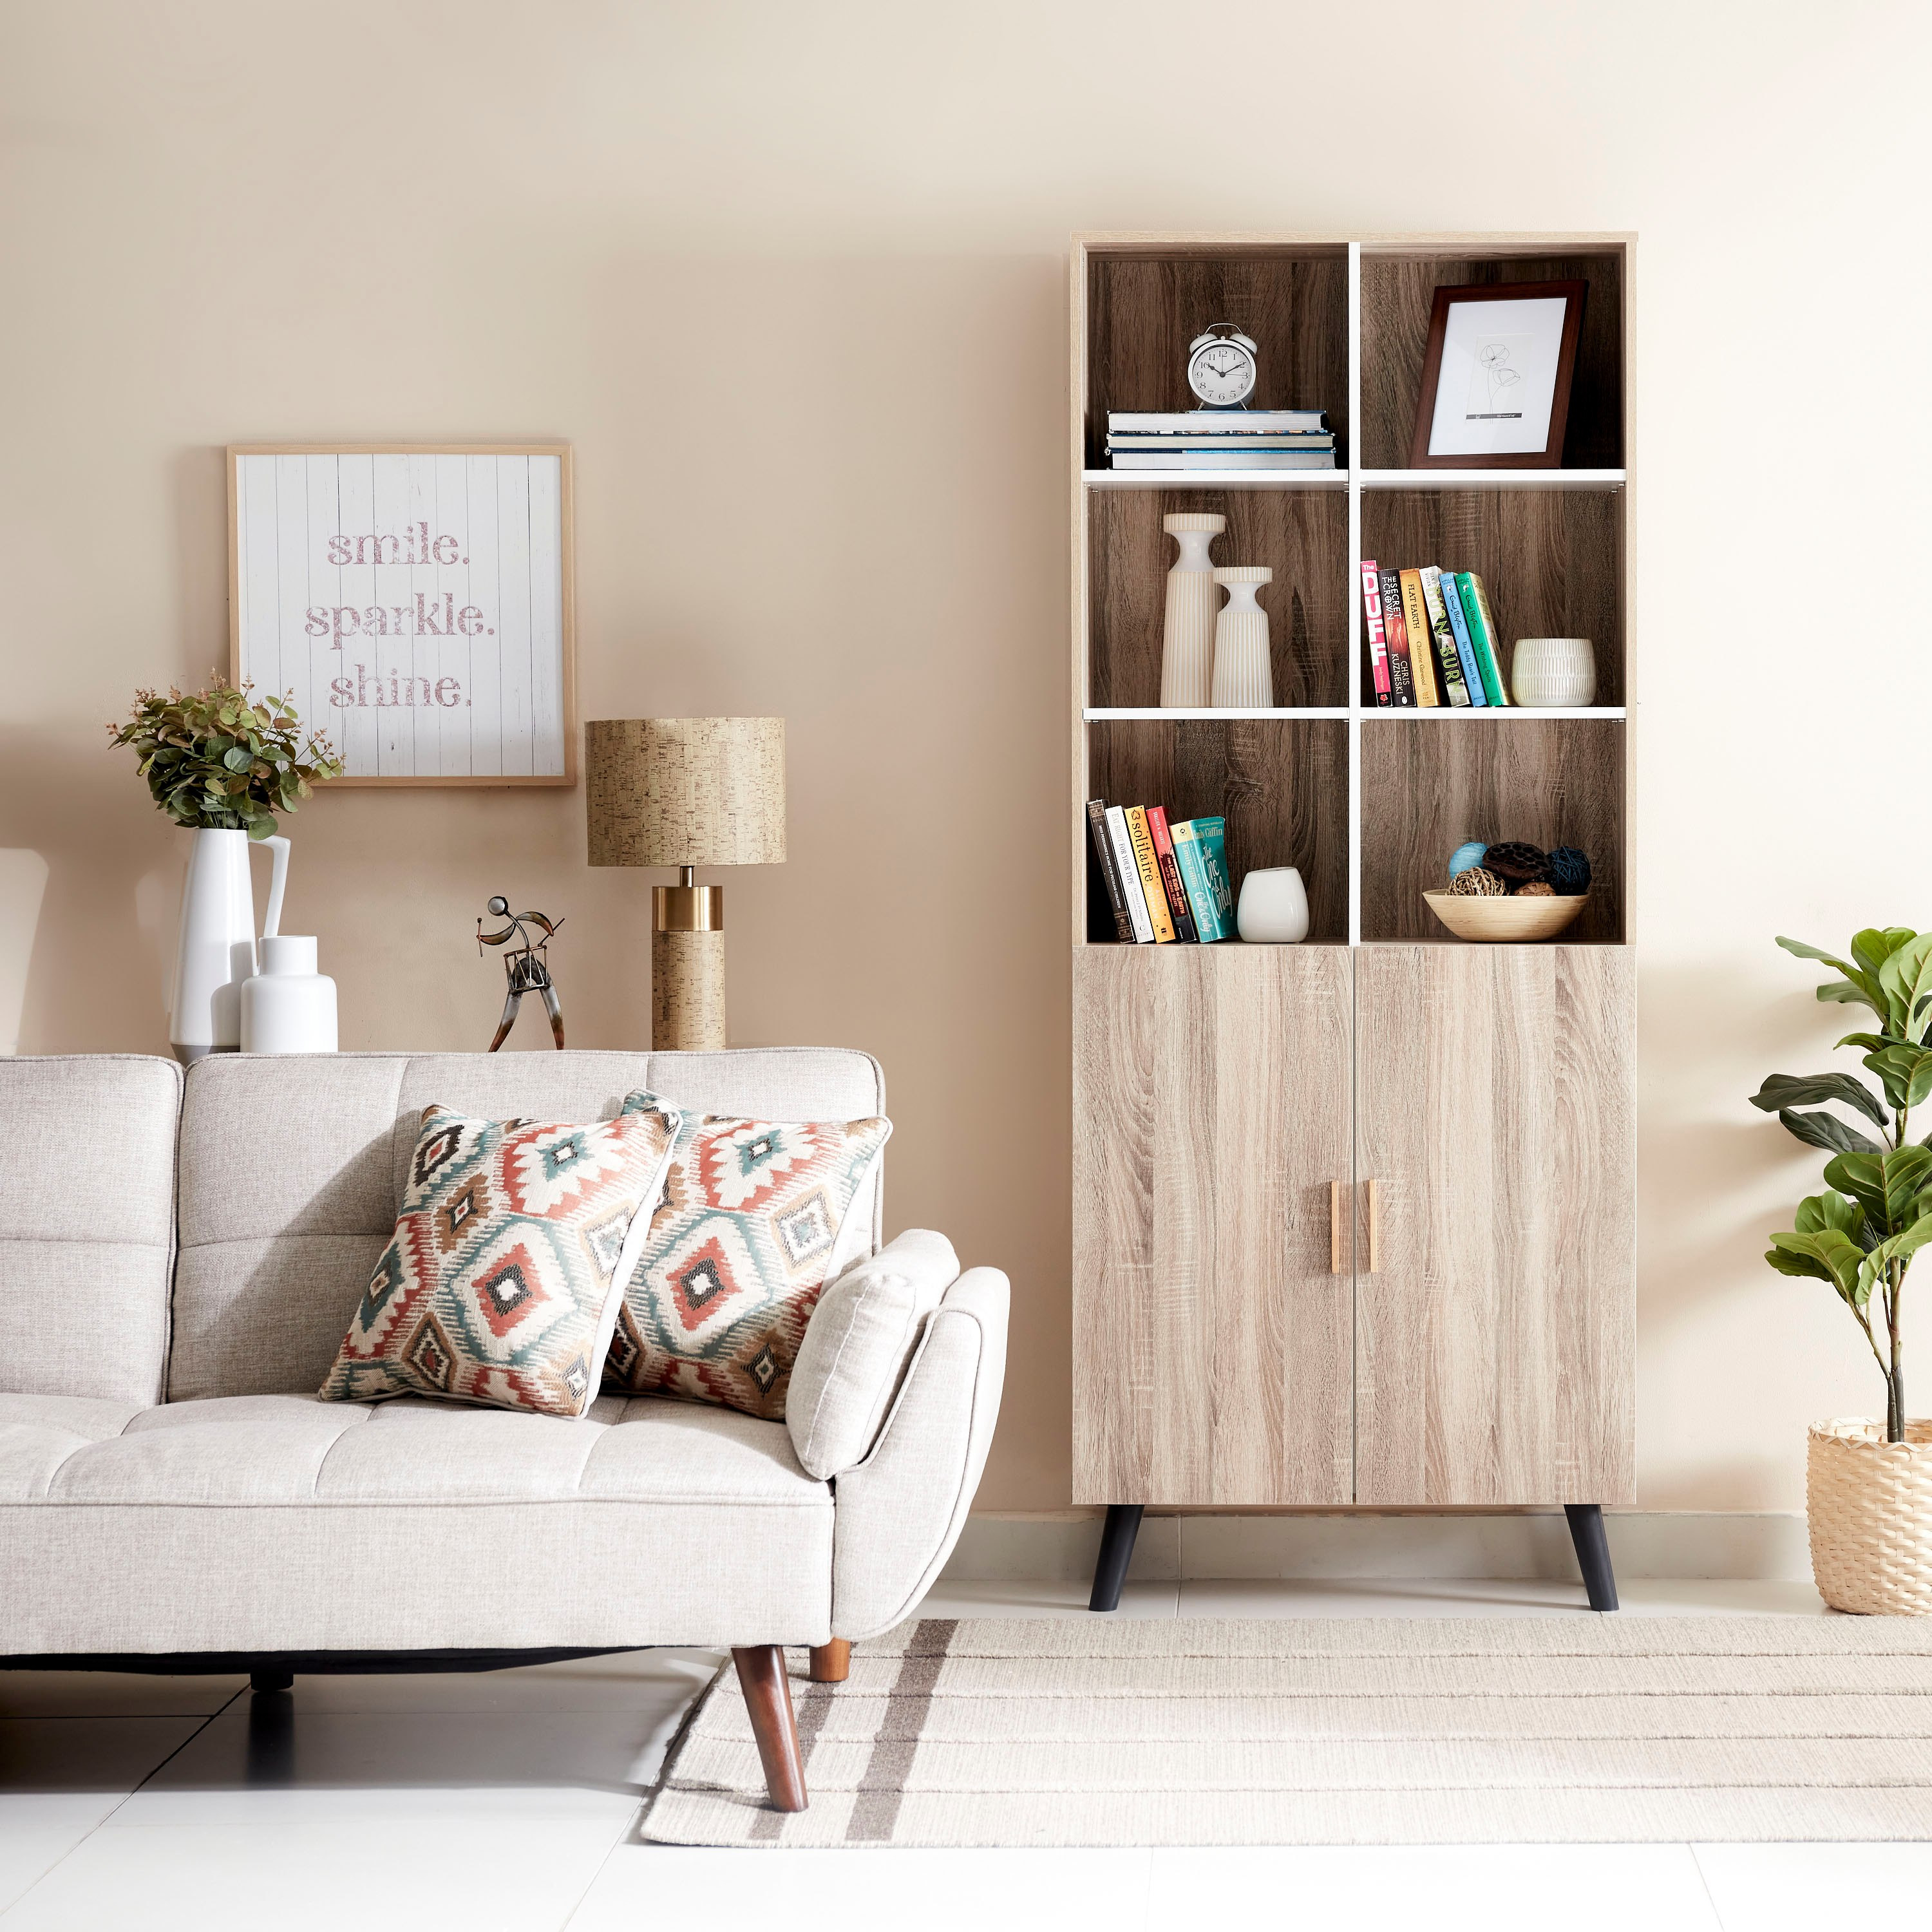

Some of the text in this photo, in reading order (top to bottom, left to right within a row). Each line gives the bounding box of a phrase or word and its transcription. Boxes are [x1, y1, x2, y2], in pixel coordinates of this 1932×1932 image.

[327, 522, 469, 565] smile.
[1361, 571, 1387, 666] DUFF
[1383, 583, 1394, 620] CROWN
[1390, 583, 1402, 620] SECRET
[1408, 583, 1420, 629] FLAT EARTH
[305, 592, 495, 650] sparkle.
[1454, 610, 1463, 629] Blyton
[1469, 610, 1478, 629] Blyton
[1426, 585, 1450, 634] BURN
[1440, 647, 1462, 694] BURN
[329, 664, 471, 708] shine.
[1392, 654, 1403, 694] KUZNESKI
[1400, 661, 1410, 685] CHRIS
[1205, 827, 1222, 837] Giffin
[1122, 855, 1131, 870] YOUR
[1132, 823, 1153, 882] solitaire
[1182, 844, 1191, 866] Emily
[1126, 872, 1134, 885] TYPE
[1146, 886, 1159, 919] OSEMAN
[1155, 889, 1165, 910] ALICE
[1177, 897, 1186, 914] EARTH
